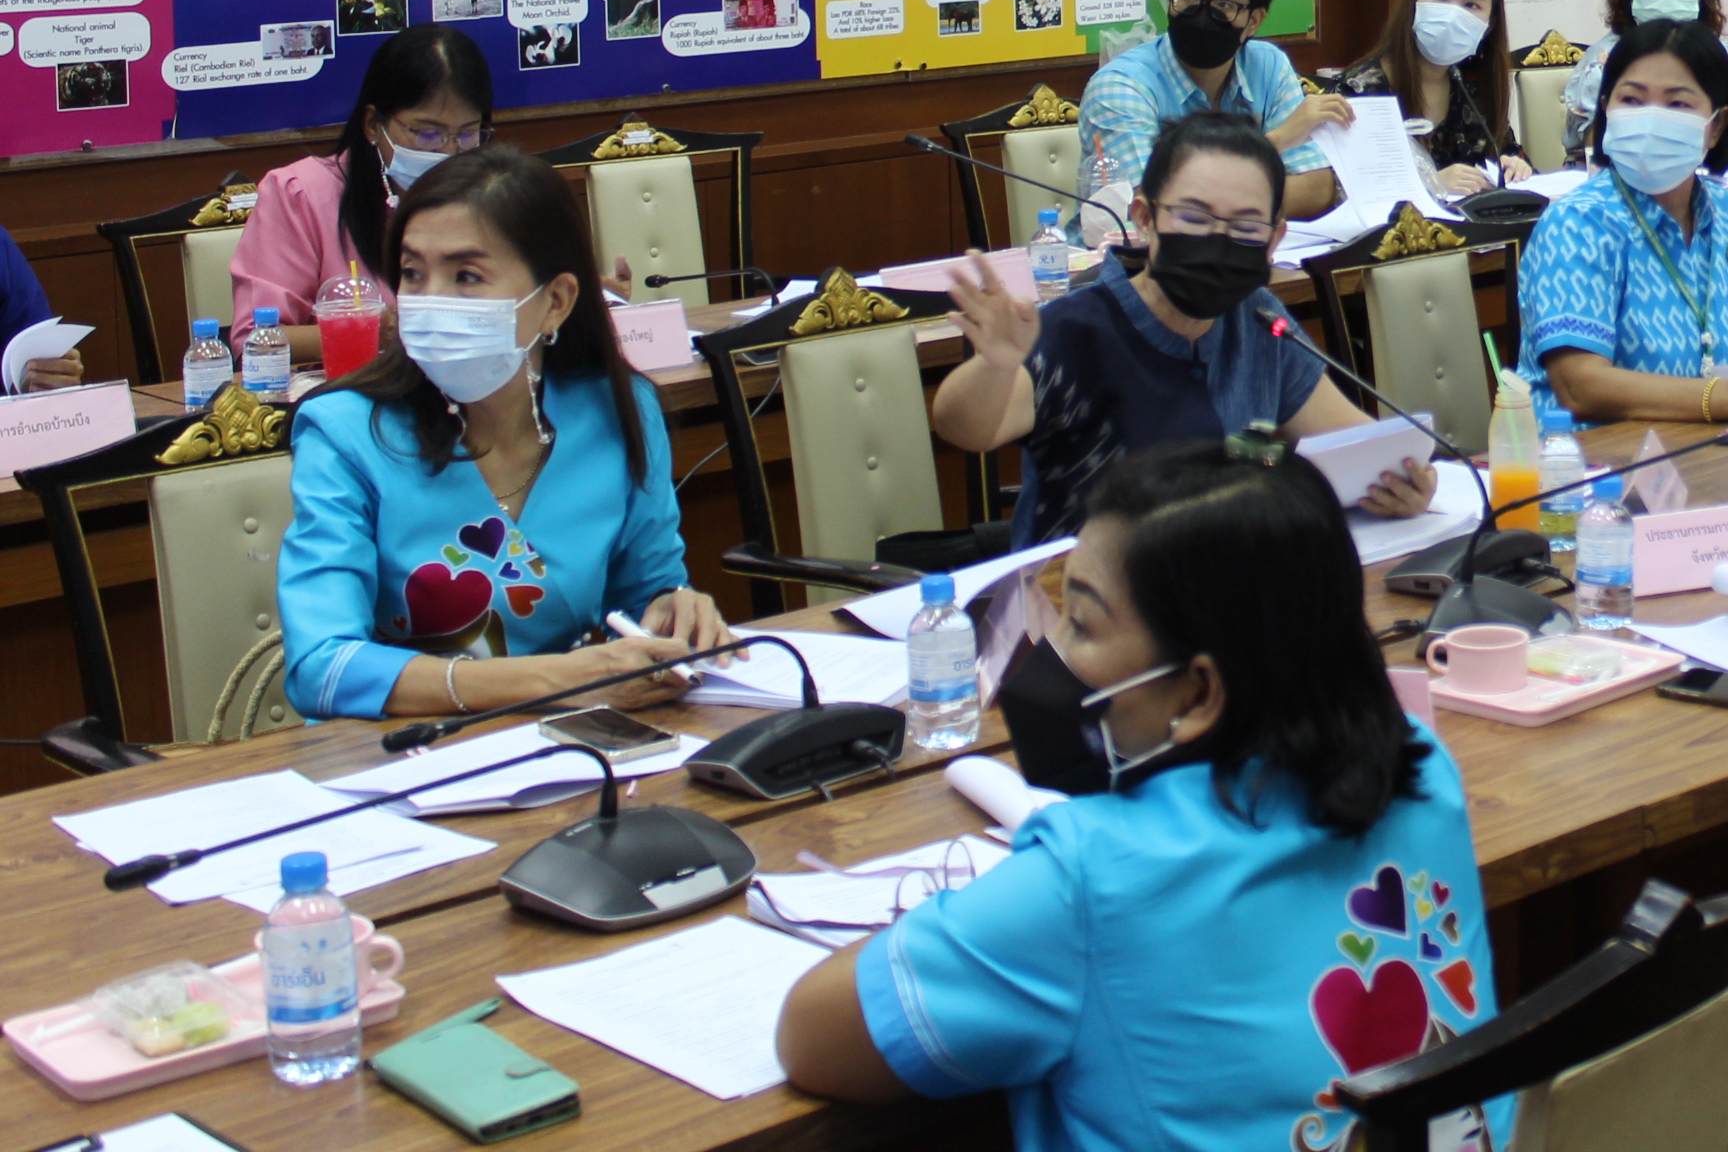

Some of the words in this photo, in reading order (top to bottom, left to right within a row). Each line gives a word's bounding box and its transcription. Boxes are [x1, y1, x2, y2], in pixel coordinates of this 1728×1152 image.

[52, 22, 86, 32] National
[89, 20, 115, 31] animal
[74, 34, 93, 46] Tiger
[173, 52, 207, 61] Currency
